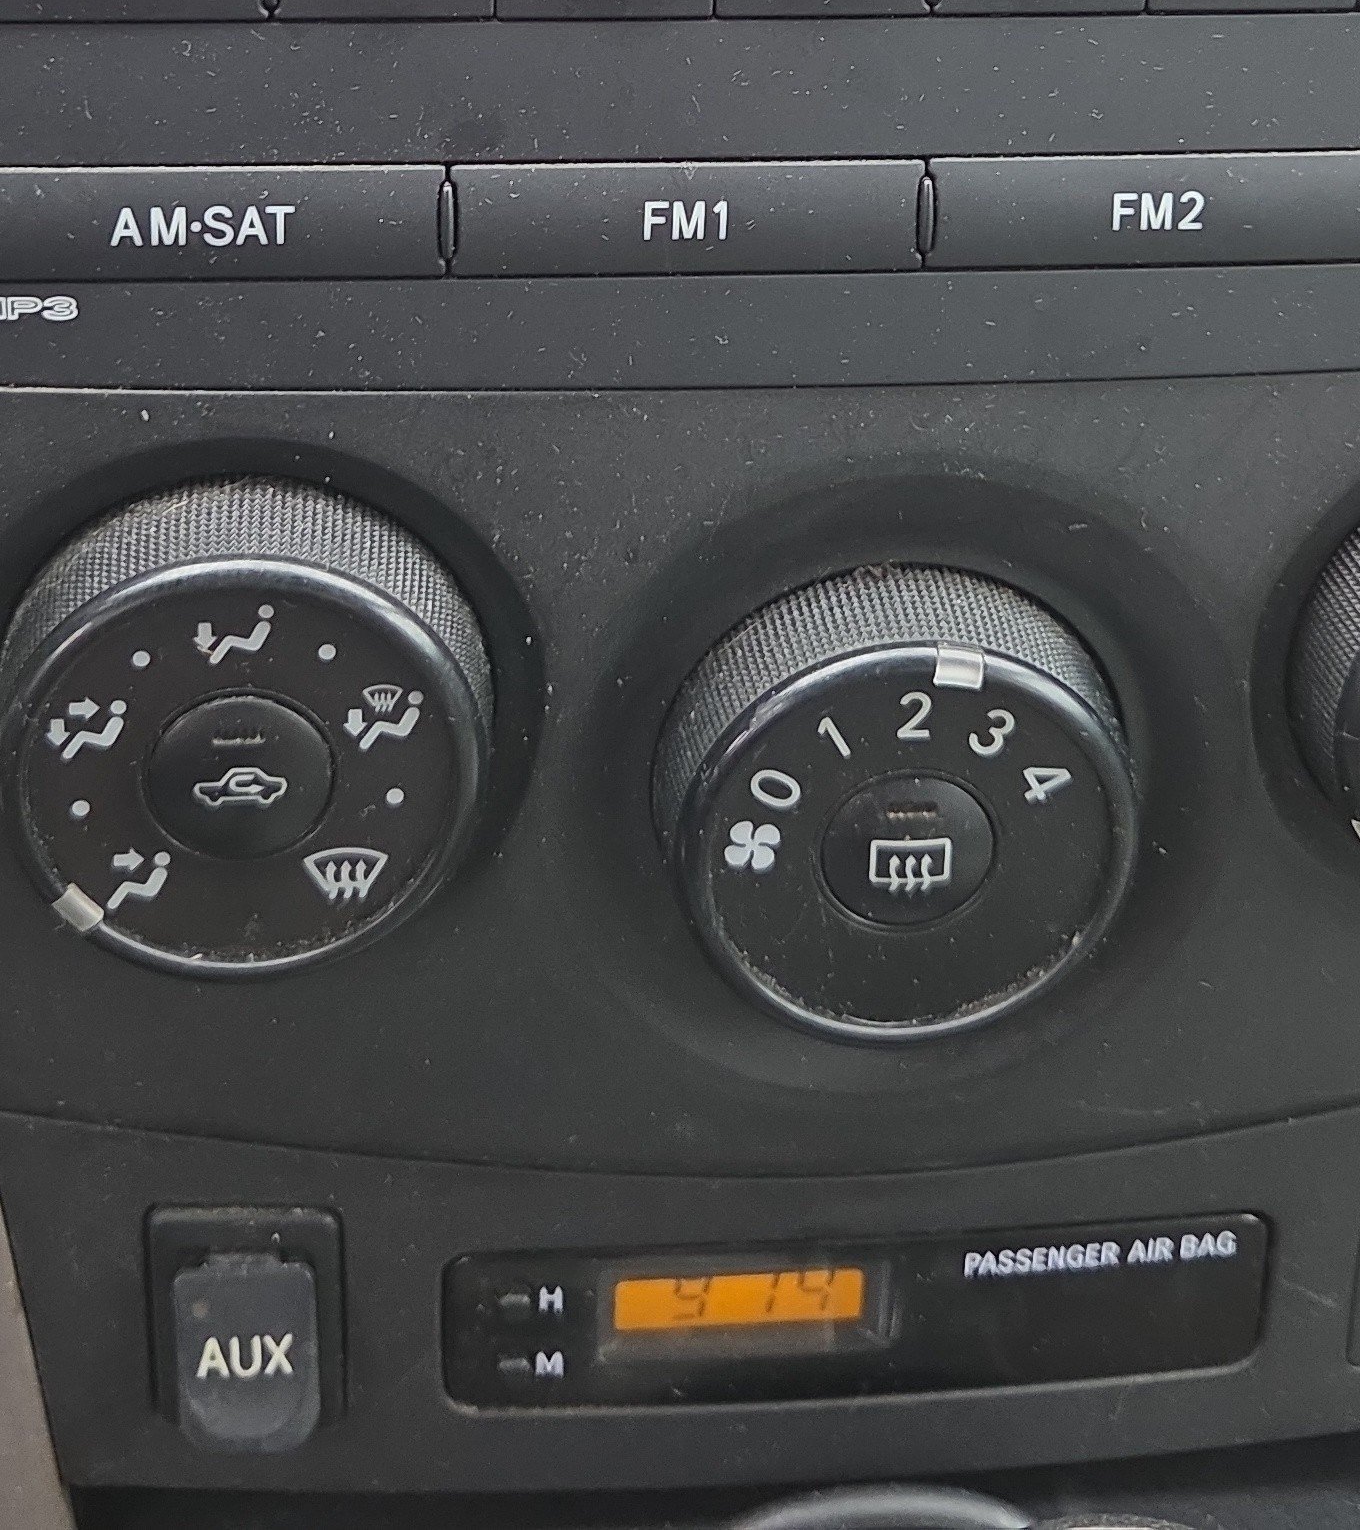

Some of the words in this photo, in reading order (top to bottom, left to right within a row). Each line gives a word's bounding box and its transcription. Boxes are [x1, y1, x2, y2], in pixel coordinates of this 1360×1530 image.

[642, 200, 729, 241] FM1
[1111, 190, 1205, 231] FM2
[750, 768, 802, 809] 0
[816, 715, 852, 759] 1
[896, 690, 933, 740] 2
[967, 708, 1016, 756] 3
[1021, 765, 1073, 803] 4
[962, 1240, 1120, 1278] PASSENGER
[1126, 1237, 1174, 1263] AIR
[1179, 1229, 1237, 1259] BAG
[538, 1284, 565, 1314] H
[195, 1332, 294, 1379] AUX
[534, 1350, 565, 1378] M
